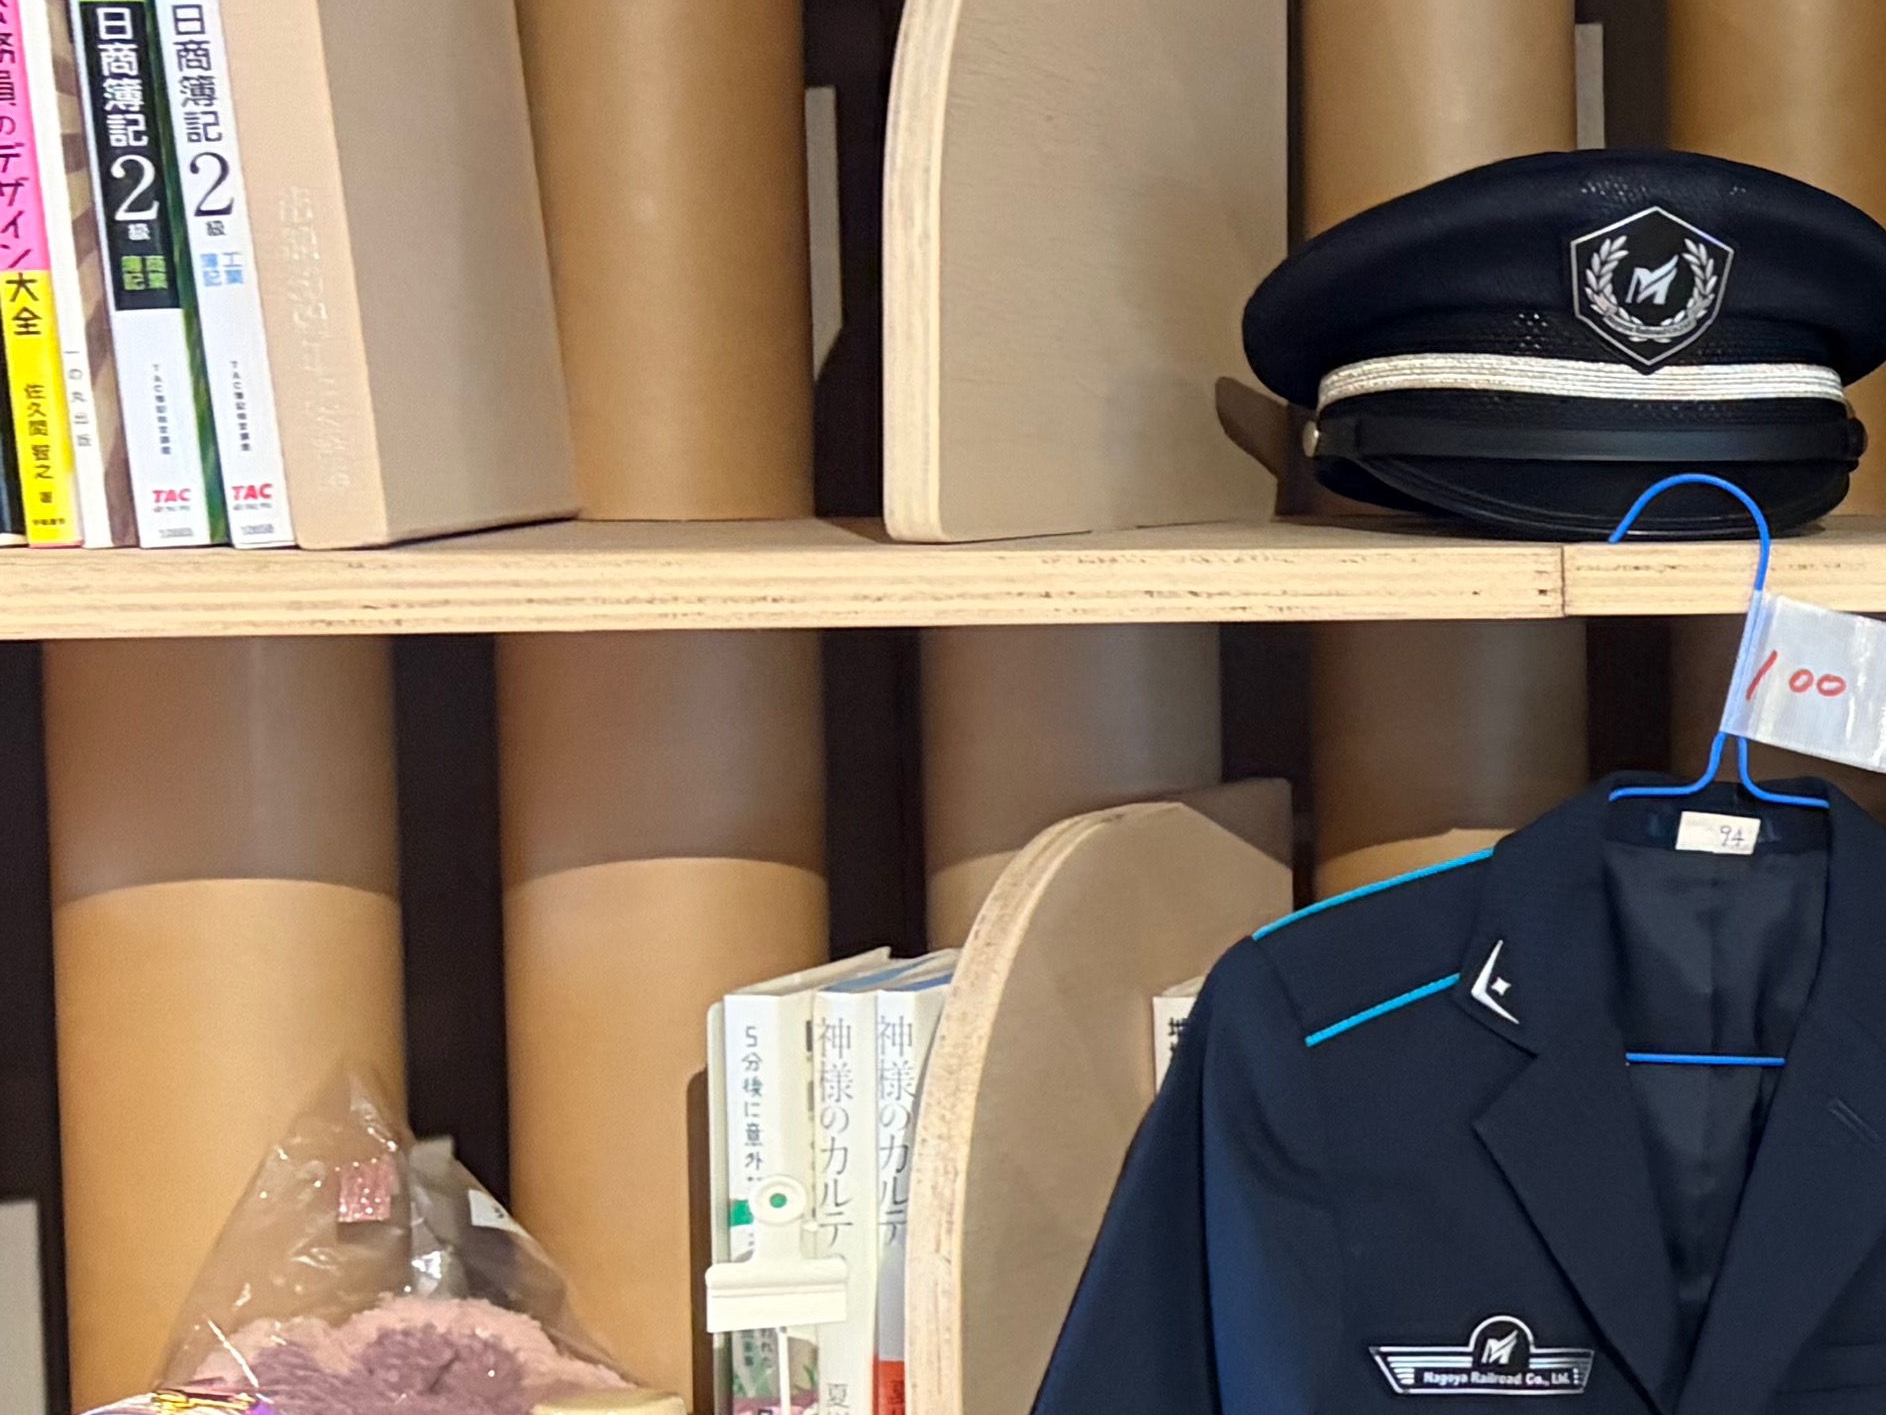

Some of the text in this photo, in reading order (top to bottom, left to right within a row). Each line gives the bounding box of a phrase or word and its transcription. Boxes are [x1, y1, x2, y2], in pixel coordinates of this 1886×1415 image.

[95, 6, 150, 148] 日商簿記
[172, 3, 224, 144] 日商簿記
[110, 153, 161, 222] 2
[189, 151, 236, 218] 2
[152, 488, 192, 504] TAC
[231, 483, 273, 500] TAC
[1743, 648, 1849, 702] 100
[742, 1026, 764, 1174] 5分後に意外
[816, 1017, 854, 1247] 神様のカルテ
[1423, 1371, 1468, 1386] Nagoya
